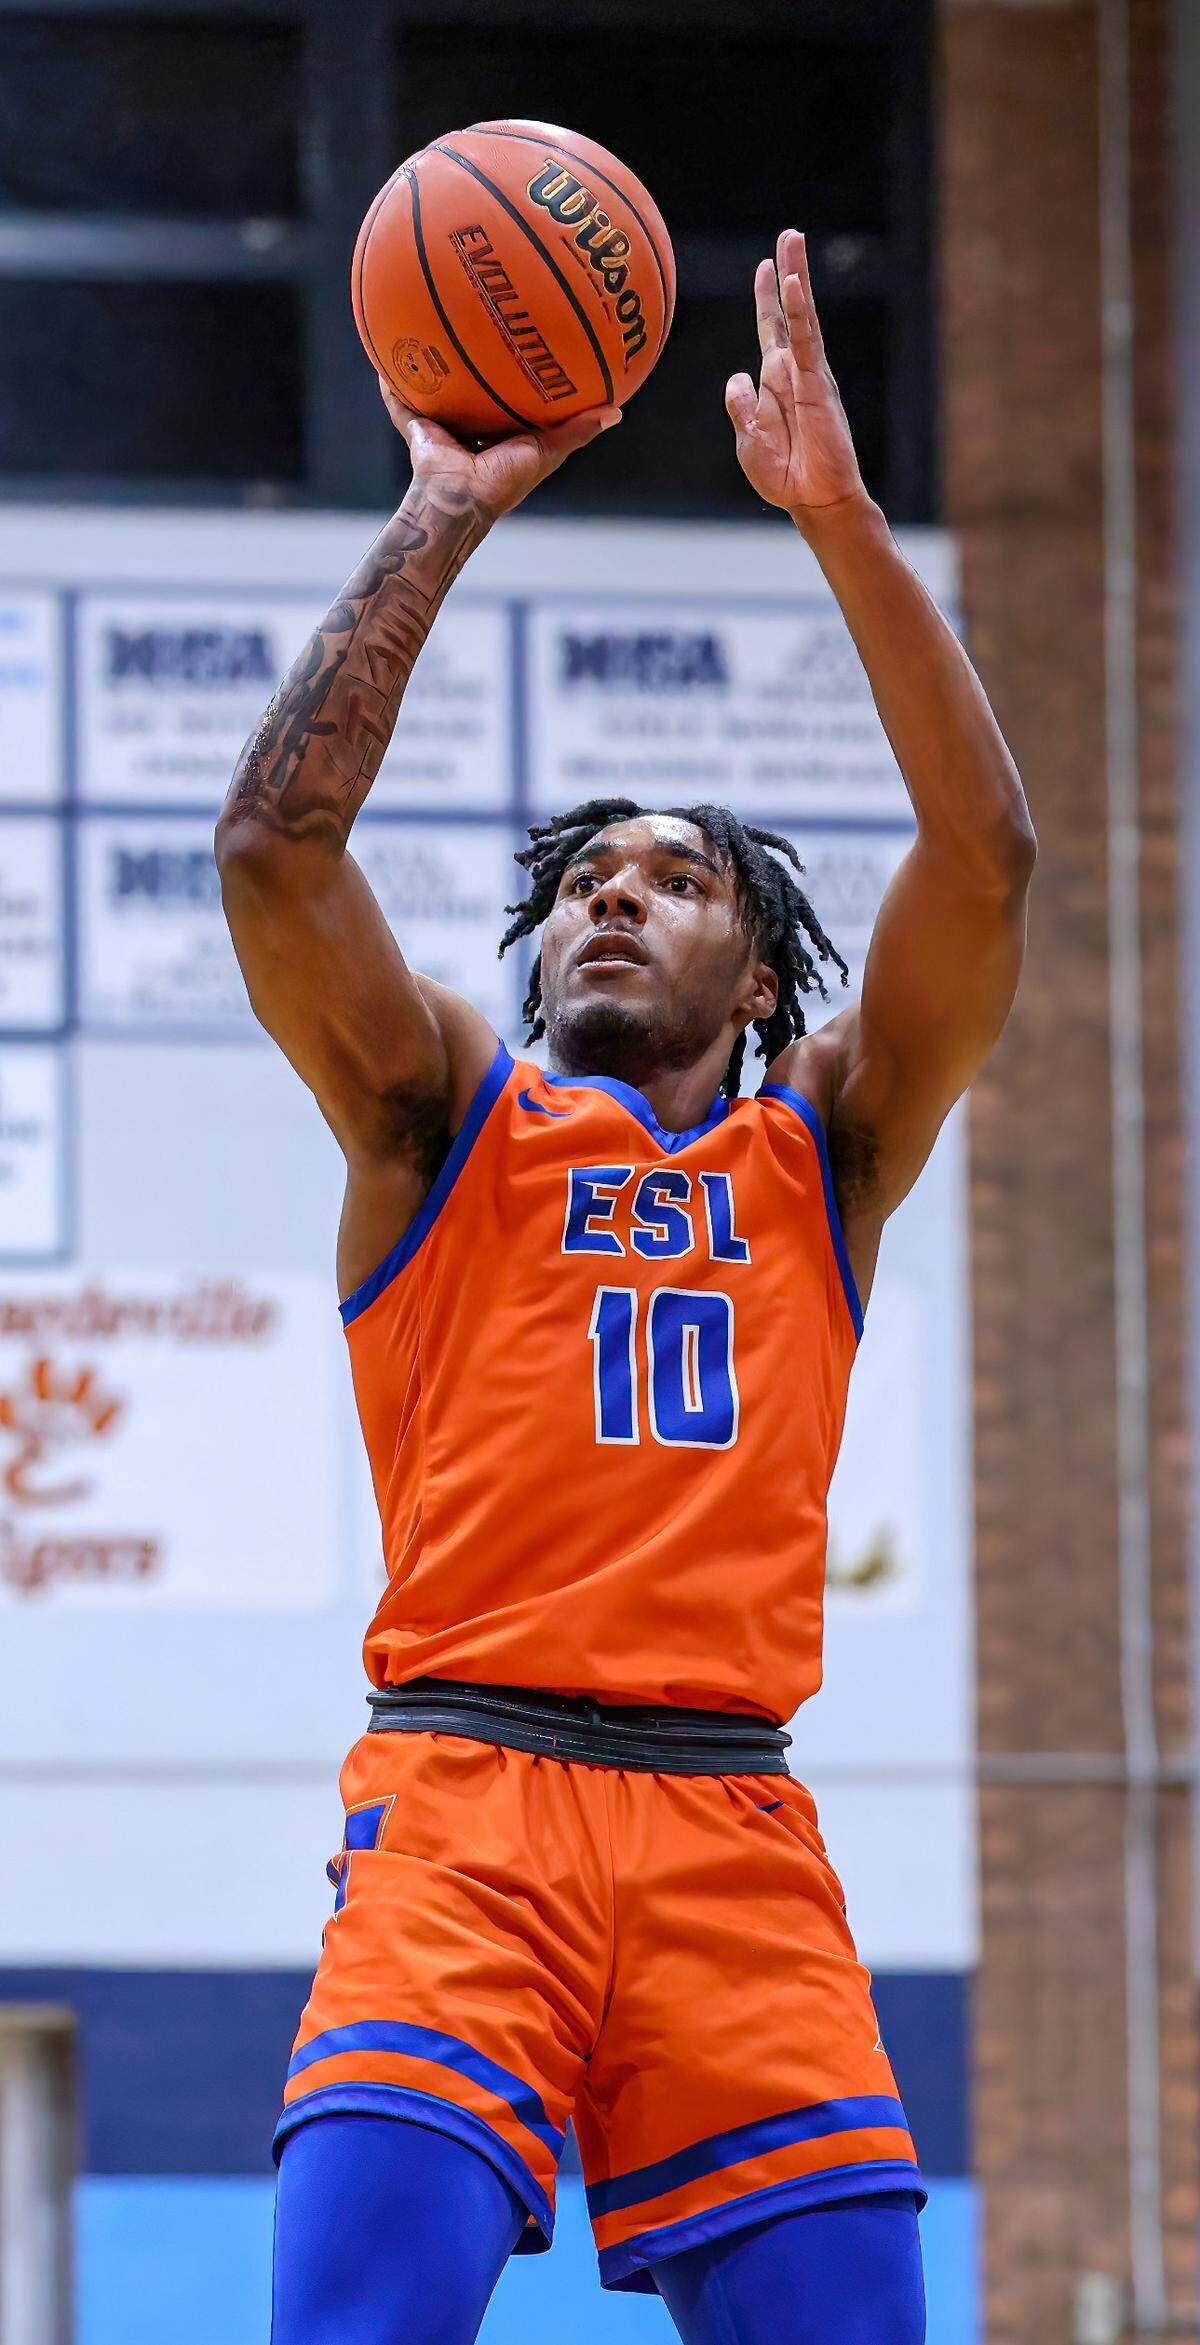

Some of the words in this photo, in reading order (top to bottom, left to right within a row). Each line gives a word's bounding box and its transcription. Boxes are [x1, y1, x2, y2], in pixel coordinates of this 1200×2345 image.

[453, 225, 578, 399] EVOLUTION
[526, 158, 648, 374] Wilson
[561, 1165, 751, 1264] ESL
[587, 1285, 739, 1450] 10
